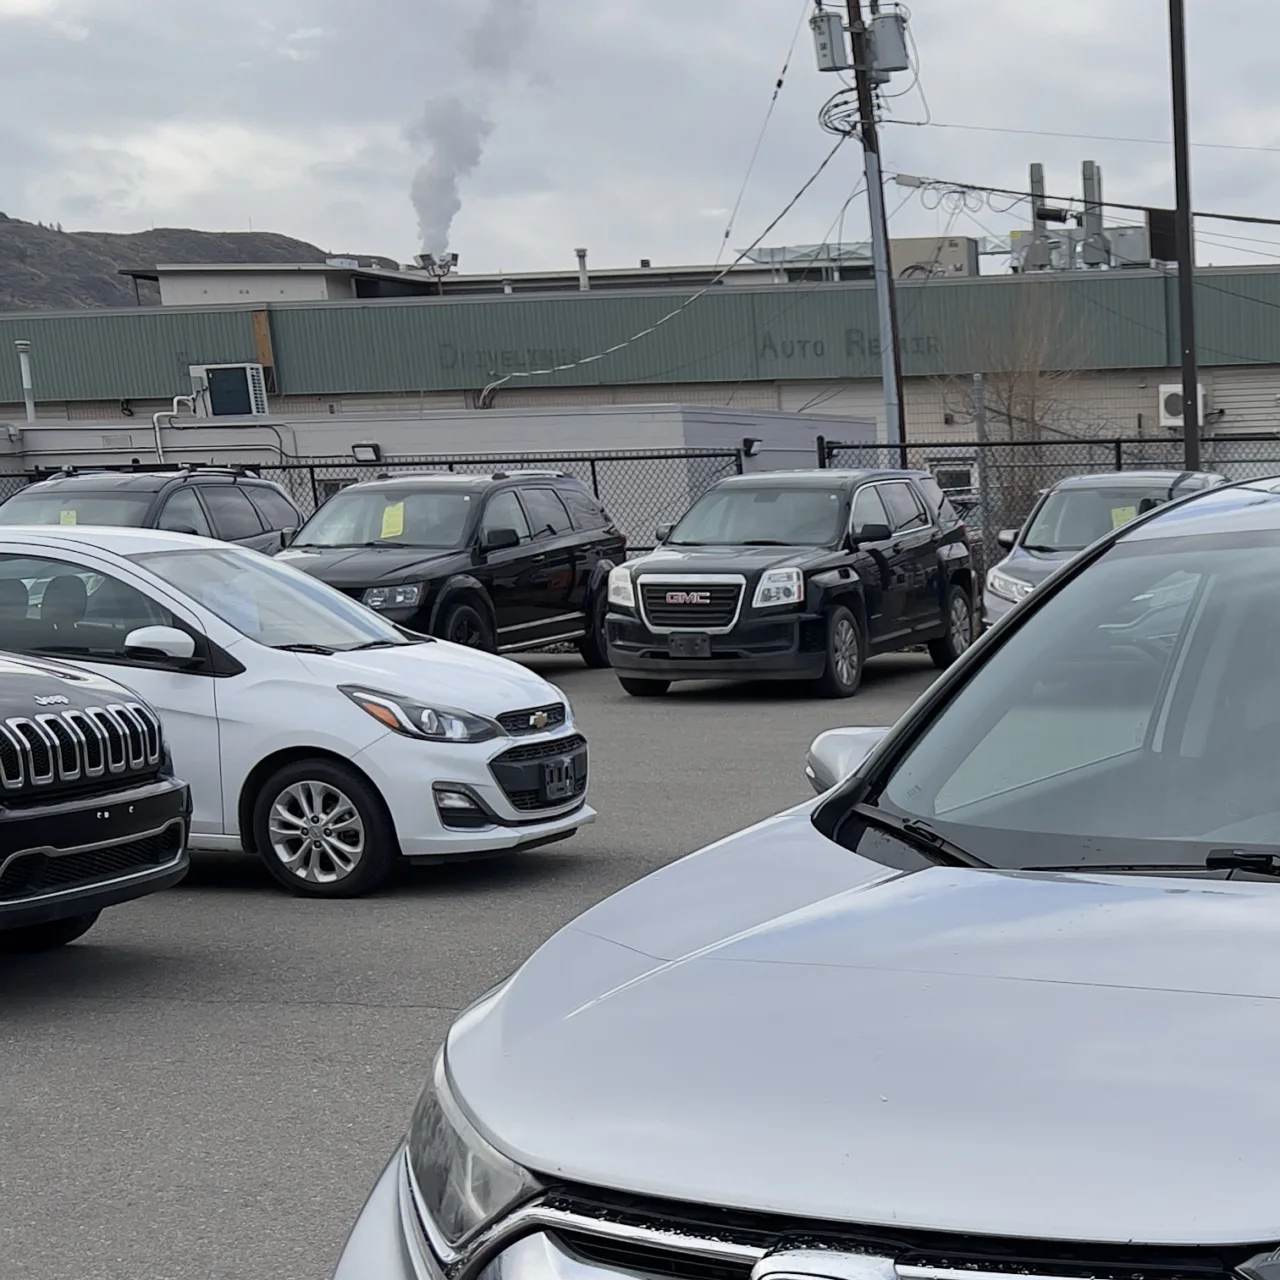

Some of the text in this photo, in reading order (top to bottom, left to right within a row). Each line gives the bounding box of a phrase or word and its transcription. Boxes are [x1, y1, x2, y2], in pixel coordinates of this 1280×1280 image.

[760, 328, 941, 359] AUTO REAIR
[666, 592, 711, 604] GMC
